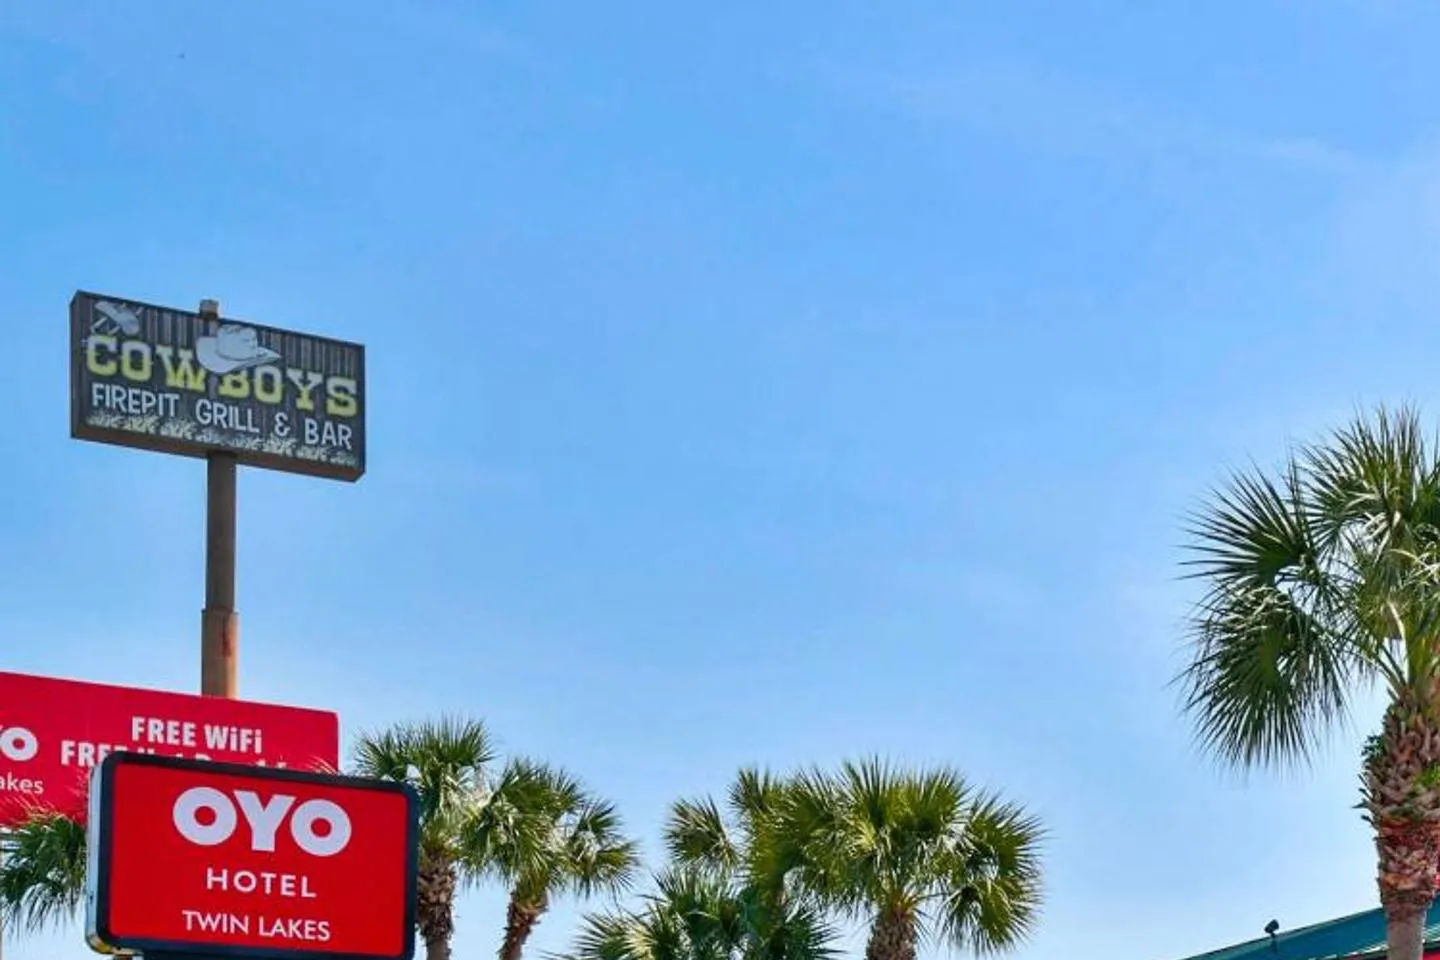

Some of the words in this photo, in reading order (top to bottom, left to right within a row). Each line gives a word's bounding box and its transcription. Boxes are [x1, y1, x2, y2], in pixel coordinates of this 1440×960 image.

[85, 334, 358, 418] COWBOYS
[92, 382, 180, 417] FIREPIT
[195, 399, 260, 433] GRILL
[274, 411, 291, 437] &
[304, 421, 352, 449] BAR
[132, 716, 197, 747] FREE
[204, 724, 263, 754] WiFi
[172, 786, 352, 857] OYO
[206, 867, 317, 898] HOTEL
[182, 910, 250, 935] TWIN
[258, 919, 331, 942] LAKES
